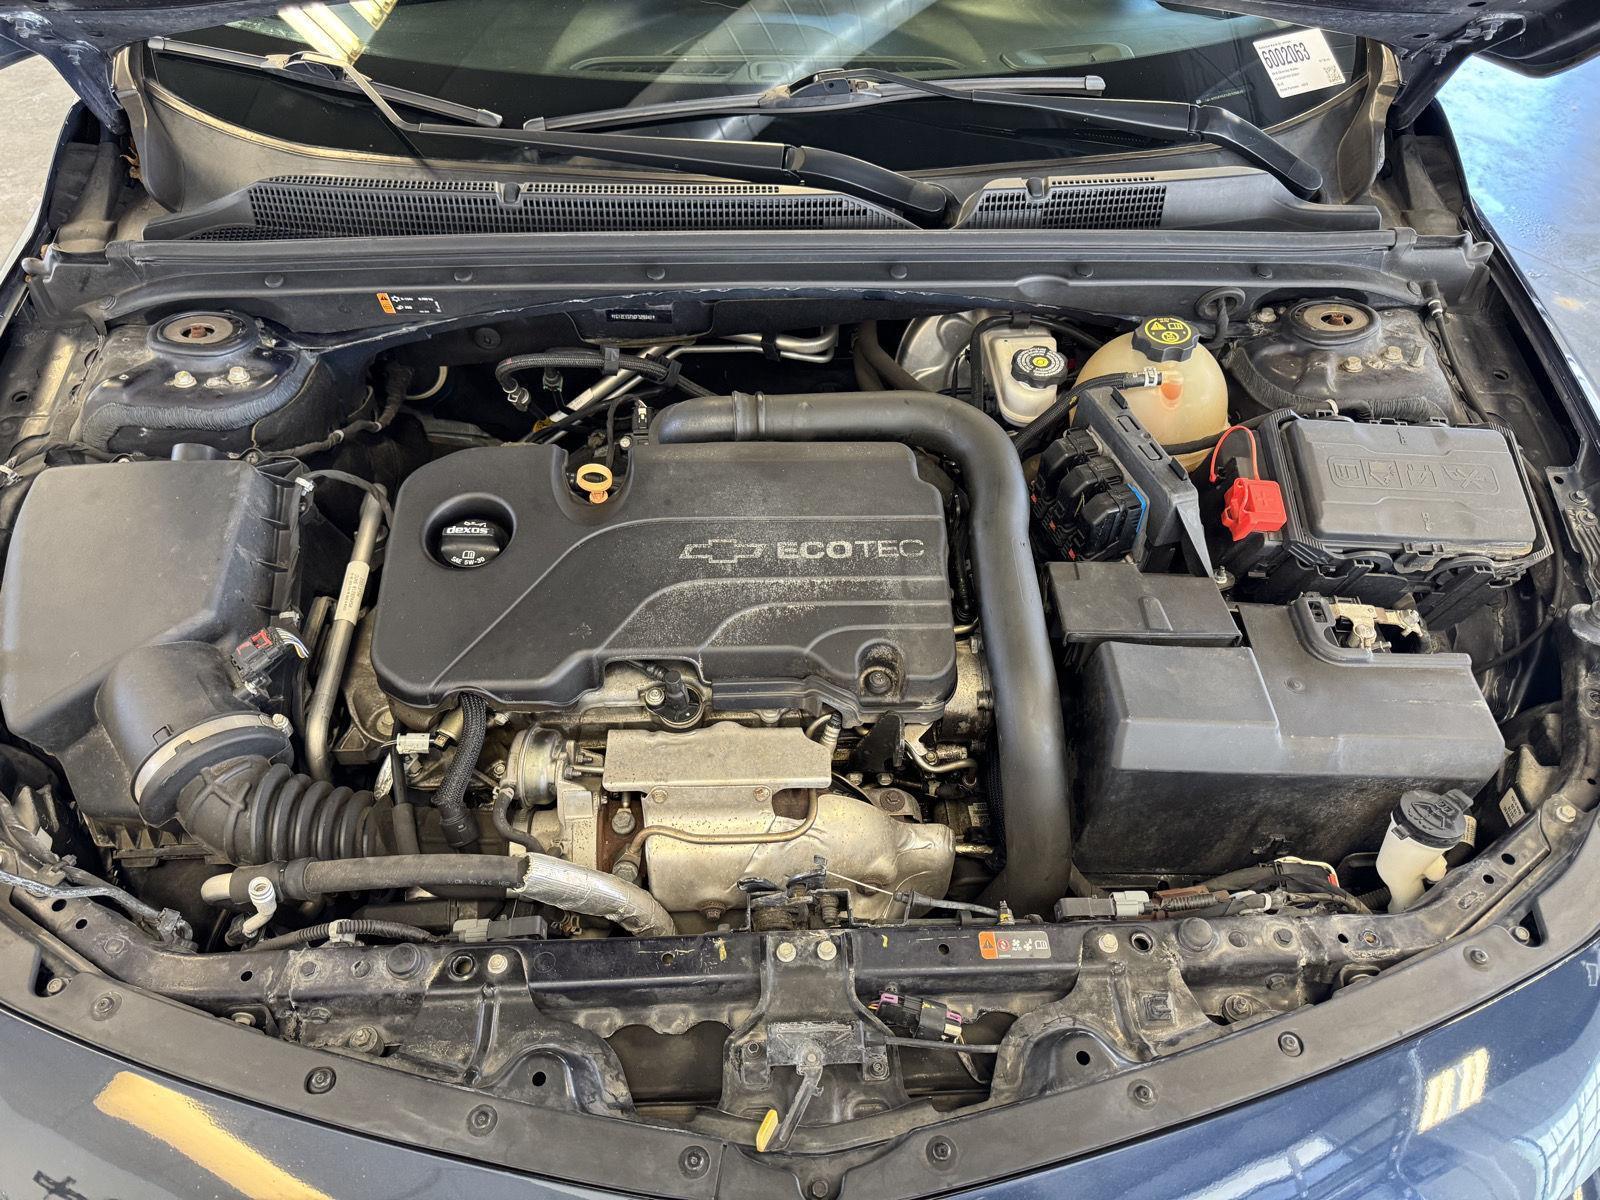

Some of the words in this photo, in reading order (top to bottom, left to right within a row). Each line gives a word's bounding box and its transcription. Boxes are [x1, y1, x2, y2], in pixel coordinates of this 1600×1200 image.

[1262, 42, 1310, 69] 6002063
[446, 525, 489, 534] dexos
[777, 539, 925, 559] ECOTEC
